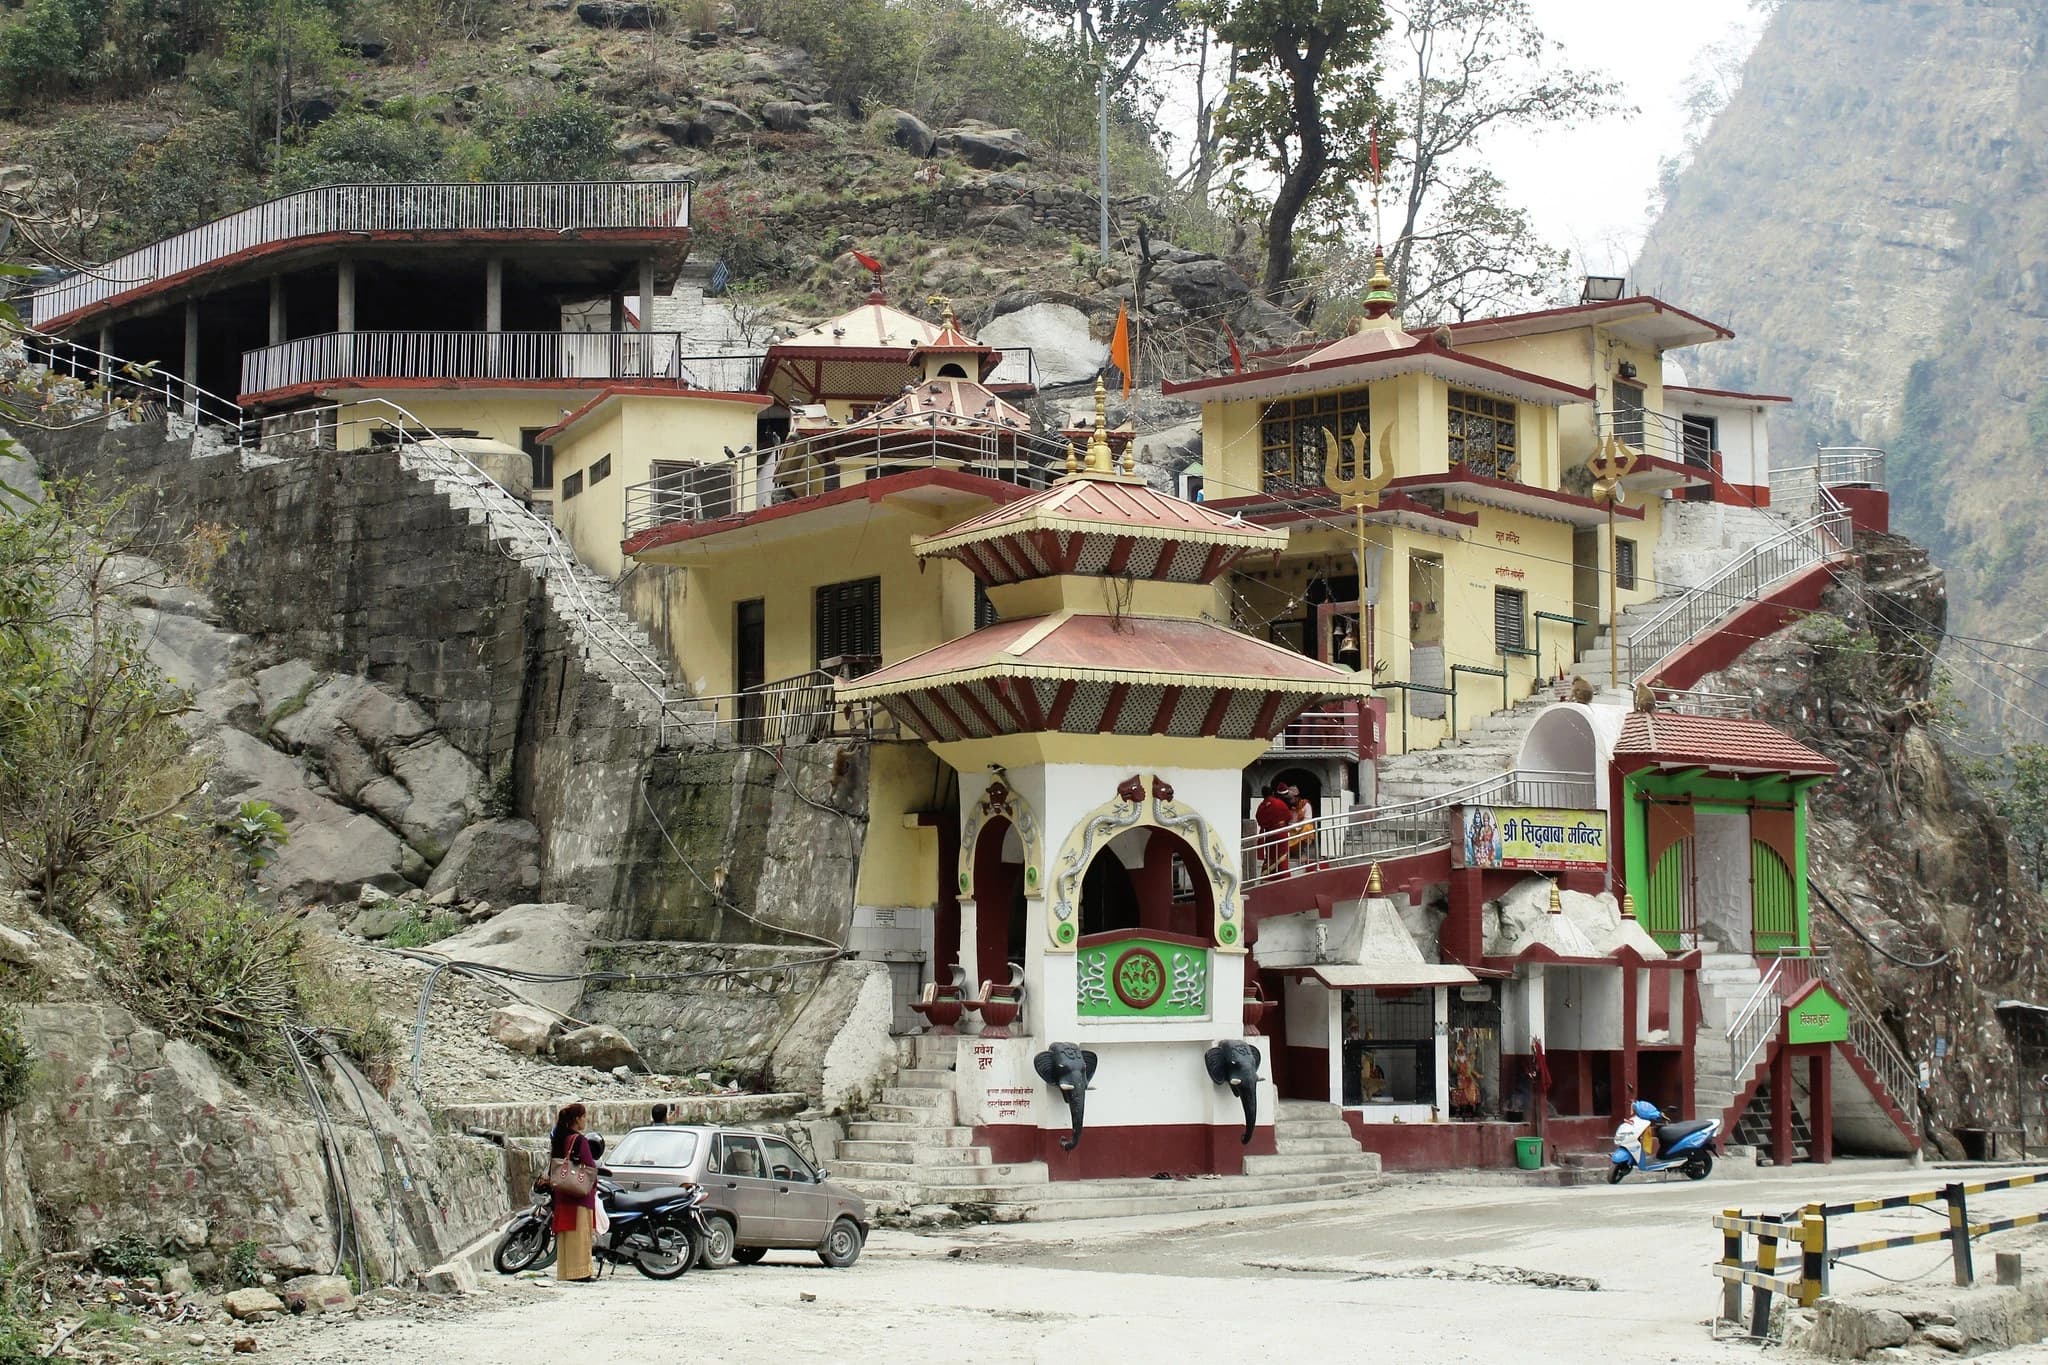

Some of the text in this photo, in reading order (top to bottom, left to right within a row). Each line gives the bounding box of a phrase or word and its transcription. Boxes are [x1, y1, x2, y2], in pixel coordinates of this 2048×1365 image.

[1504, 818, 1518, 842] श्री
[1568, 822, 1603, 846] मन्दिर
[974, 1043, 994, 1055] प्रवेश
[978, 1057, 993, 1070] द्वार
